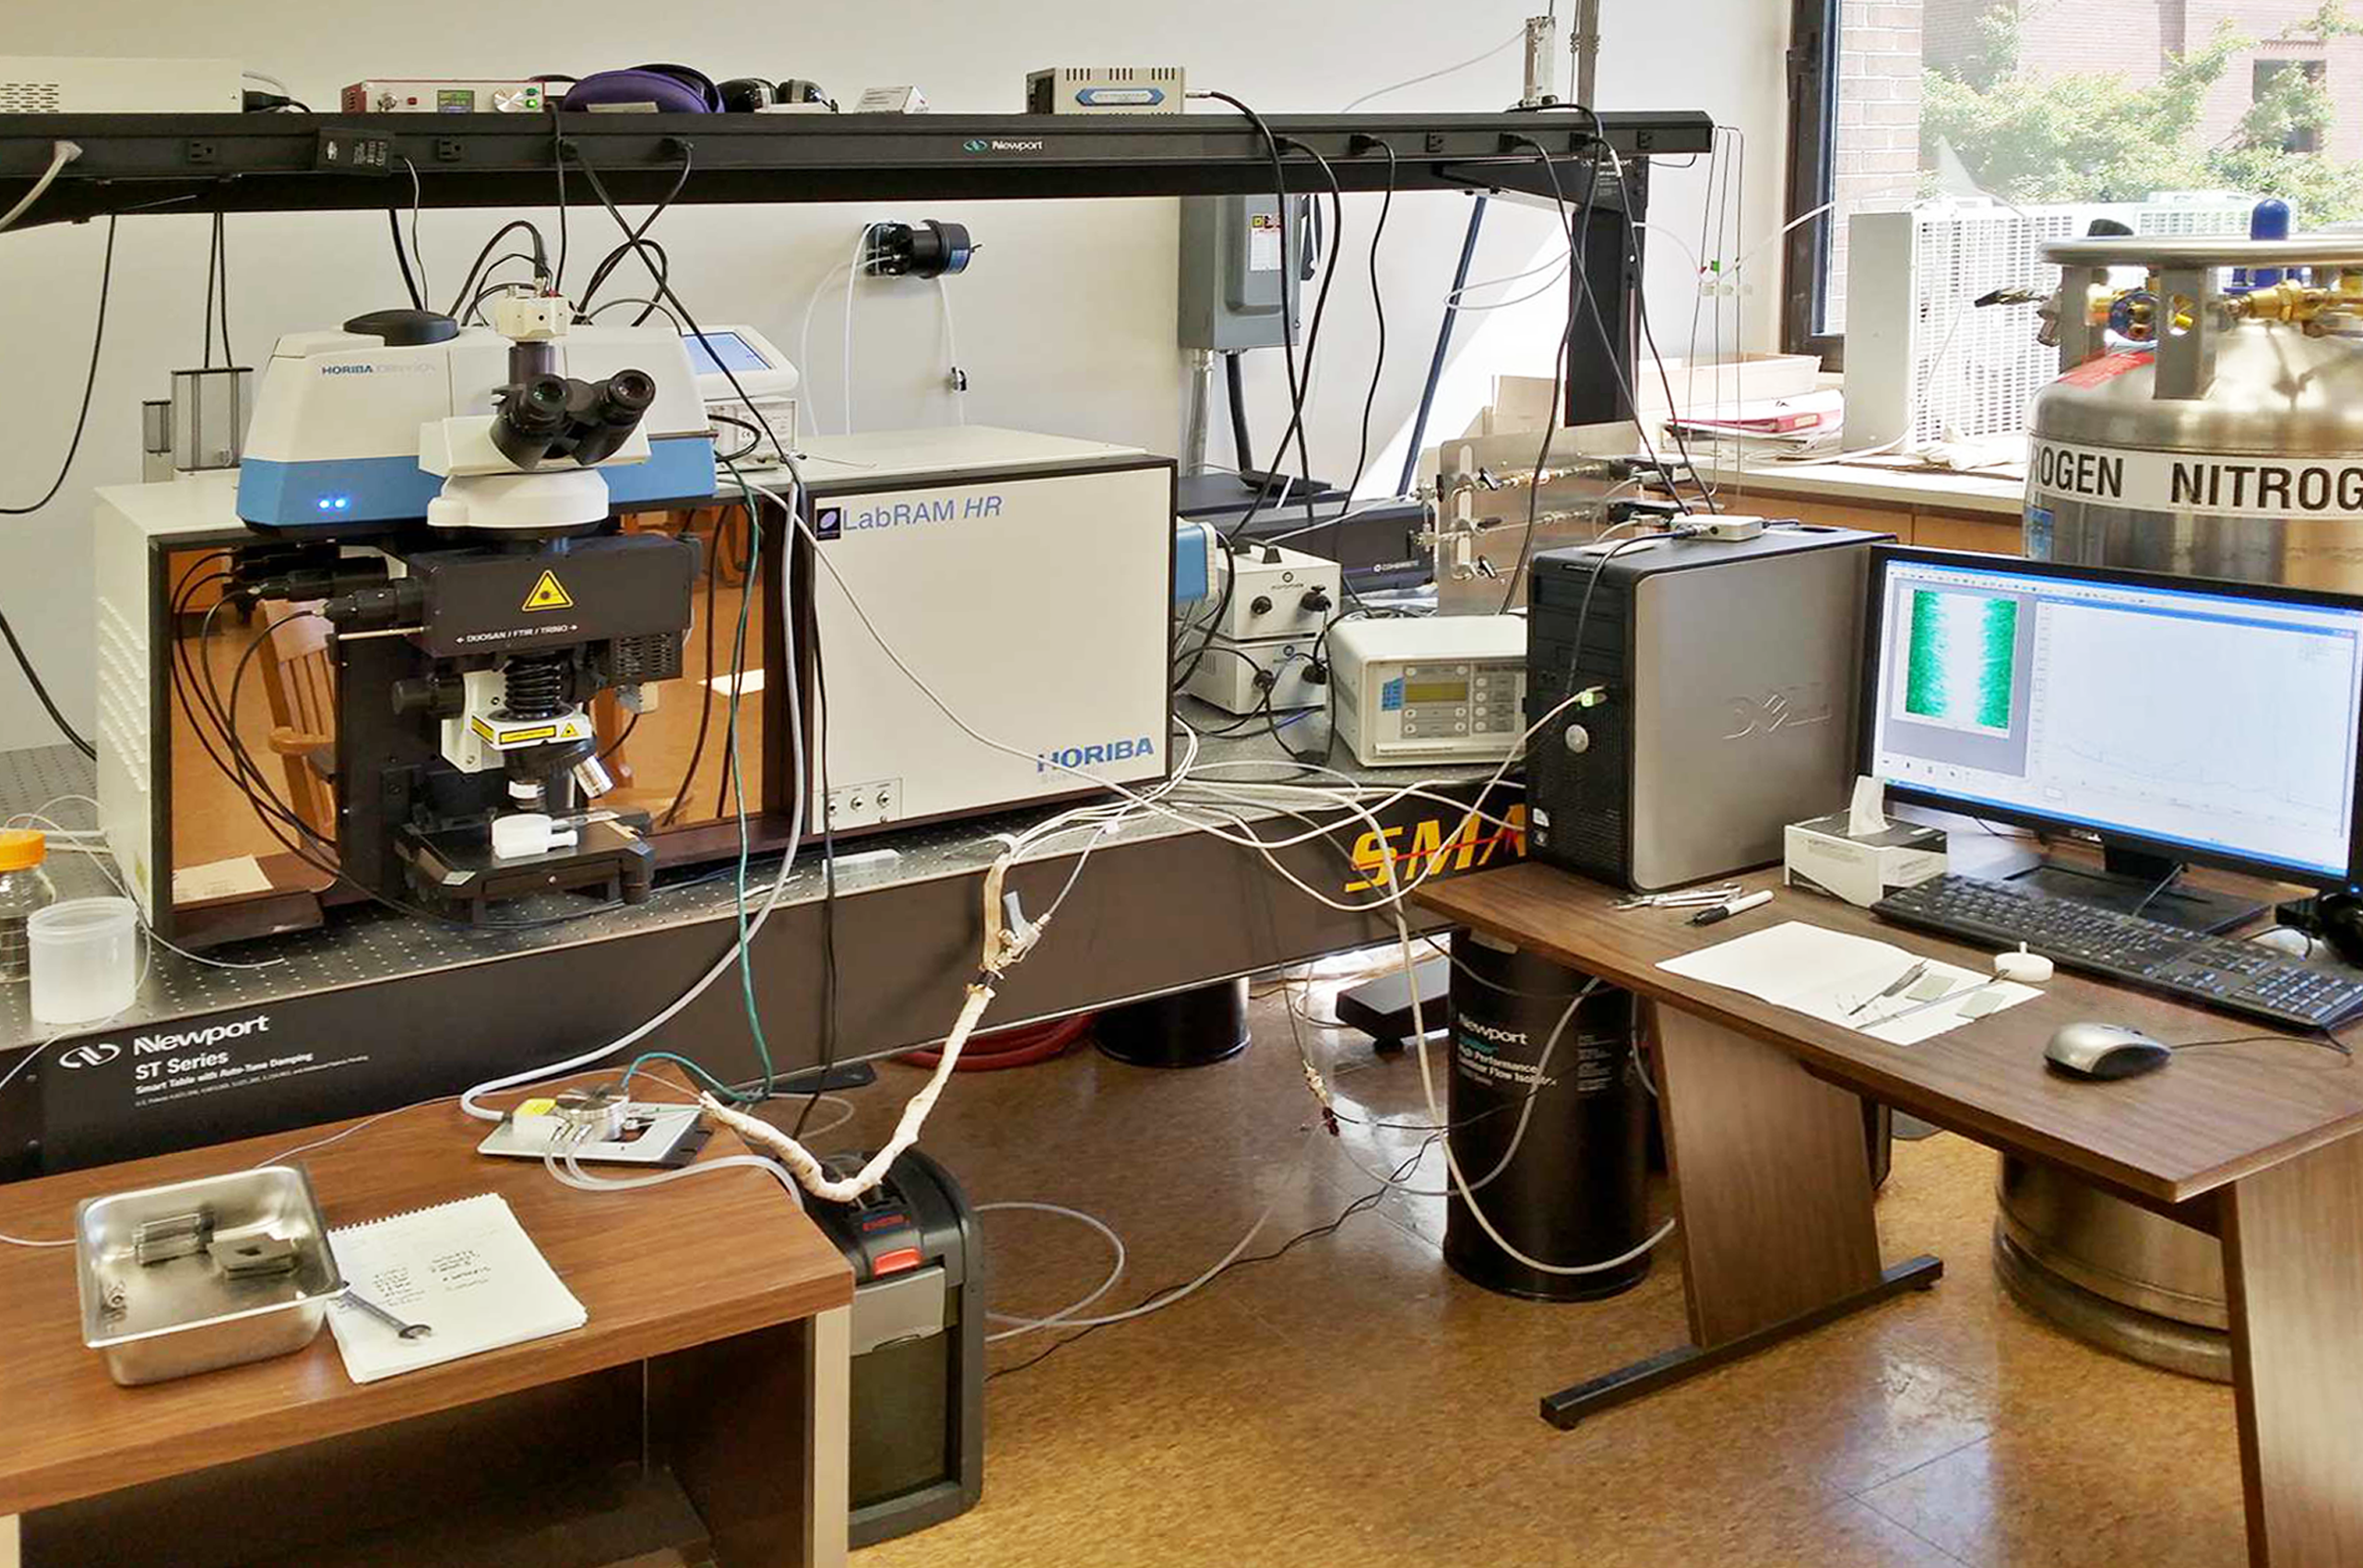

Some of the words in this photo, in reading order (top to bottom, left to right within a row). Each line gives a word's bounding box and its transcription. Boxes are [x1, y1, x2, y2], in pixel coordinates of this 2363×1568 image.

[992, 140, 1042, 151] Newport
[2171, 462, 2363, 511] NITROG
[843, 499, 955, 531] LabRAM
[964, 495, 1003, 518] HR
[1038, 737, 1155, 773] HORIBA
[134, 1016, 269, 1056] Newport
[135, 1061, 163, 1080] ST
[167, 1051, 230, 1075] Series
[136, 1081, 167, 1095] Smart
